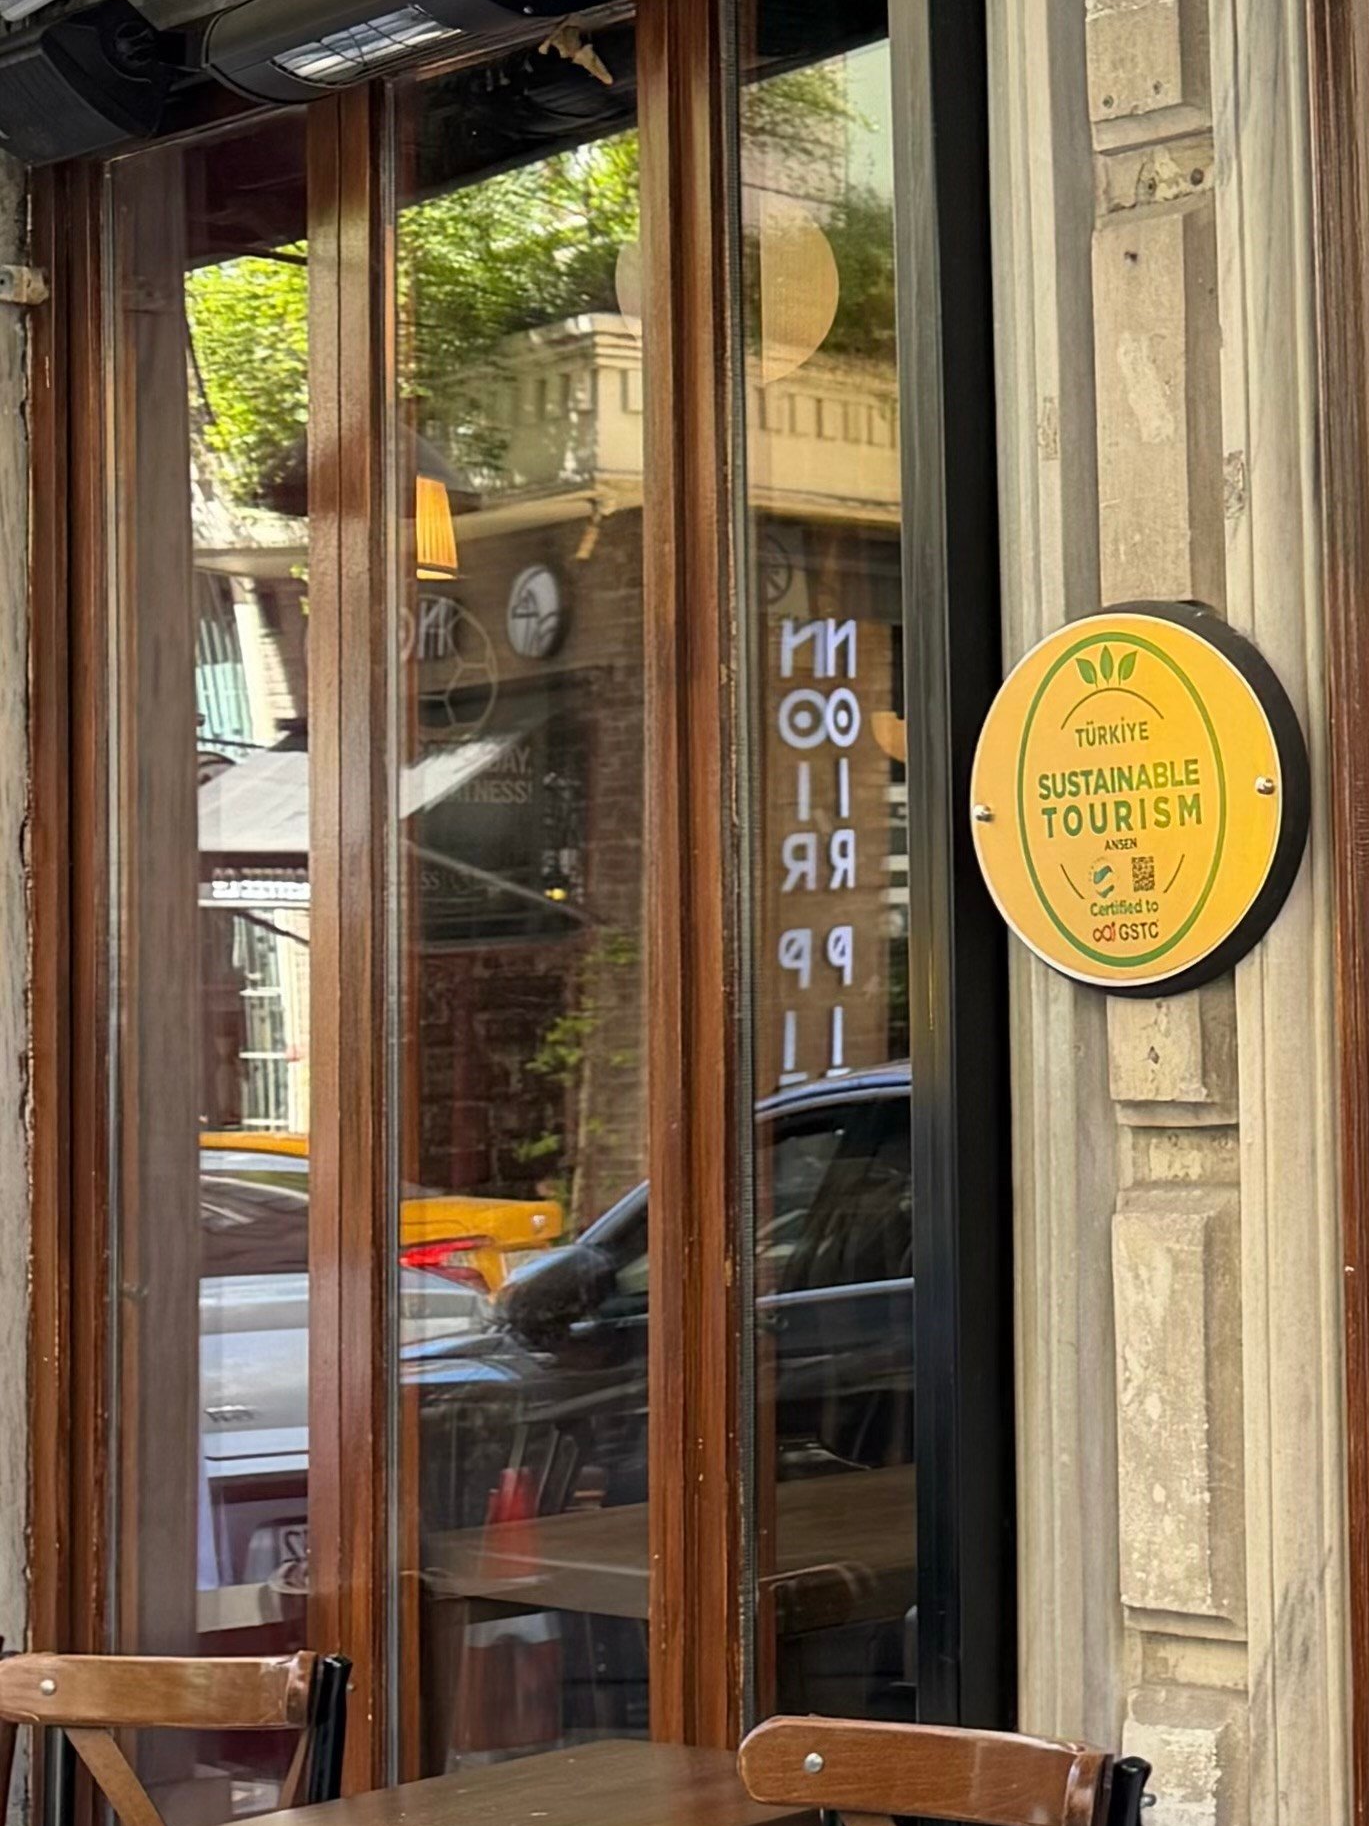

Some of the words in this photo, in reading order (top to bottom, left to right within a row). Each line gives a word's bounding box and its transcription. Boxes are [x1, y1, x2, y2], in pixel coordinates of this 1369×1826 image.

[1075, 716, 1149, 748] TÜRKİYE
[1038, 758, 1201, 801] SUSTAINABLE
[1041, 792, 1203, 839] TOURISM
[1104, 837, 1138, 852] ANSEN
[1090, 898, 1143, 917] Certified
[1146, 899, 1159, 913] to
[1118, 921, 1159, 942] GSTC
